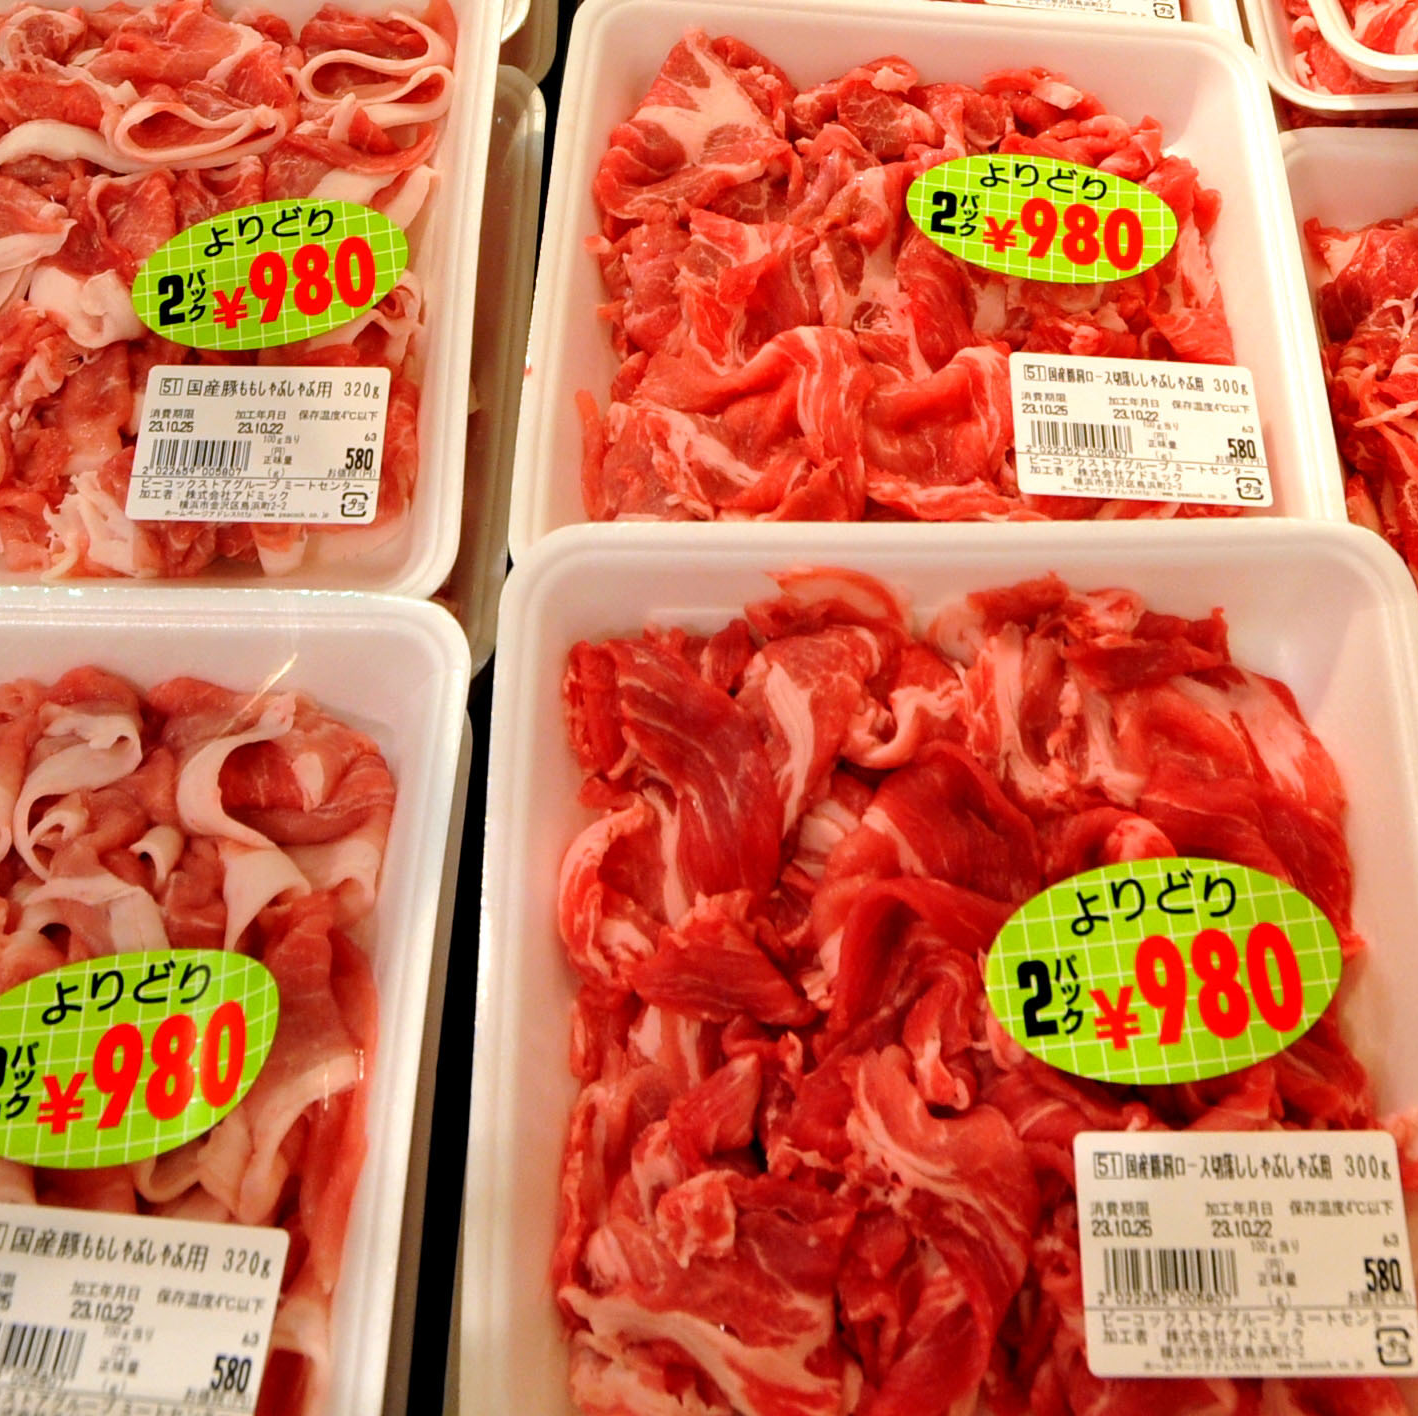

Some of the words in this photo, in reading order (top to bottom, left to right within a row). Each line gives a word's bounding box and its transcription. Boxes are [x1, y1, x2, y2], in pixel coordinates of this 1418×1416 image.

[980, 163, 1108, 200] よりどり
[204, 208, 333, 258] よりどり
[187, 379, 332, 398] 国産豚ももしゃぶしゃぶ用
[344, 382, 379, 399] 320g
[1214, 379, 1248, 395] 300g
[150, 409, 194, 419] 消費期限
[235, 411, 286, 420] 加工年月日
[1022, 404, 1068, 415] 23.10.25
[1113, 410, 1159, 421] 23.10.22
[149, 421, 193, 432] 23.10.25
[238, 423, 283, 434] 23.10.22
[365, 433, 377, 441] 63
[346, 448, 373, 470] 580
[1229, 439, 1256, 459] 580
[1070, 869, 1237, 936] よりどり
[42, 961, 212, 1025] よりどり
[1345, 1155, 1391, 1180] 300g
[1092, 1220, 1152, 1237] 23.10.25
[1212, 1220, 1272, 1238] 23.10.22
[11, 1230, 208, 1272] 国産豚ももしゃぶしゃぶ用
[222, 1249, 272, 1278] 320g
[1365, 1258, 1401, 1292] 580
[211, 1355, 252, 1392] 580
